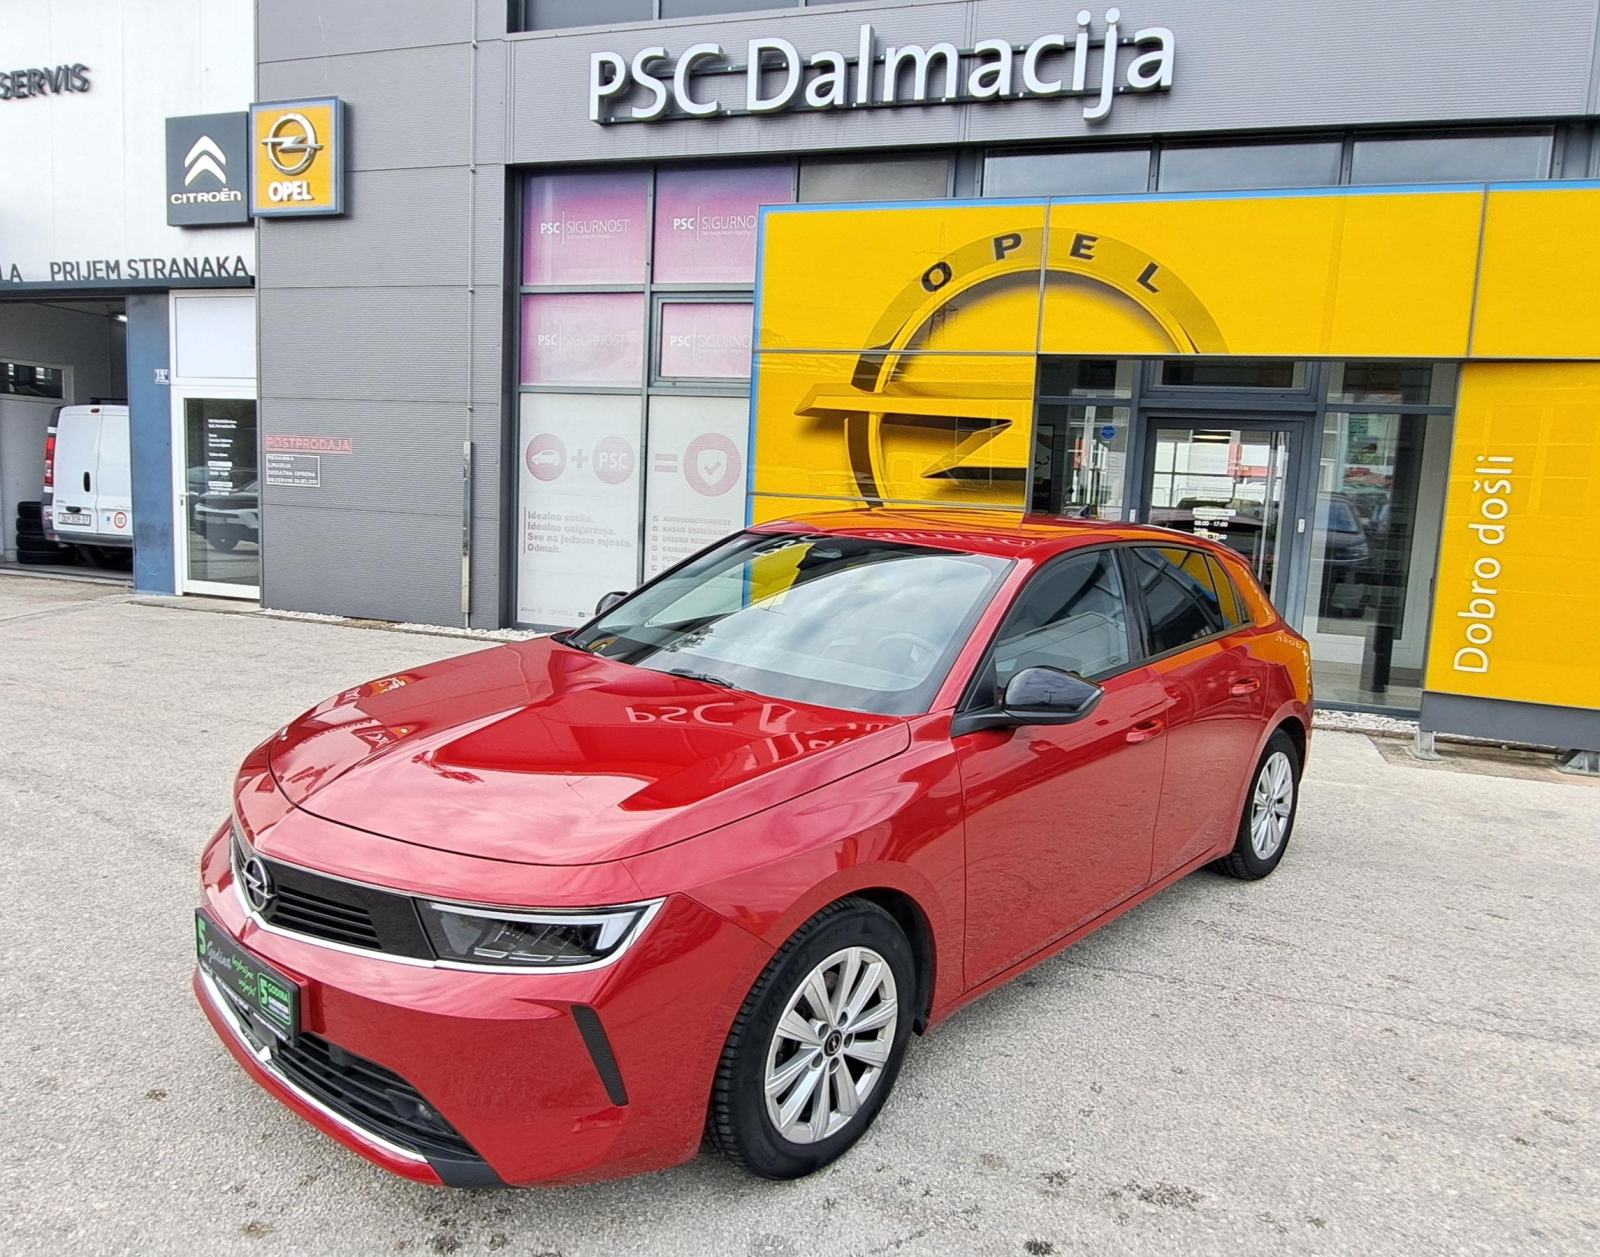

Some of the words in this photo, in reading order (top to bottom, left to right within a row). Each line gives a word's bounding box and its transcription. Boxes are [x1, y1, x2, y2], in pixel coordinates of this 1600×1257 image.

[589, 43, 724, 123] PSC
[745, 8, 1176, 122] Dalmacija
[0, 63, 90, 100] SERVIS
[268, 181, 314, 202] OPEL
[540, 222, 560, 234] PSC
[566, 218, 631, 234] SIGURNOST
[673, 216, 695, 231] PSC
[50, 259, 121, 282] PRIJEM
[128, 255, 250, 280] STRANAKA
[920, 232, 1161, 294] OPEL
[538, 334, 557, 346] PSC
[670, 335, 690, 348] PSC
[599, 452, 629, 469] PSC
[1468, 455, 1515, 545] došli
[527, 511, 562, 521] Idealno
[1454, 557, 1502, 673] Dobro
